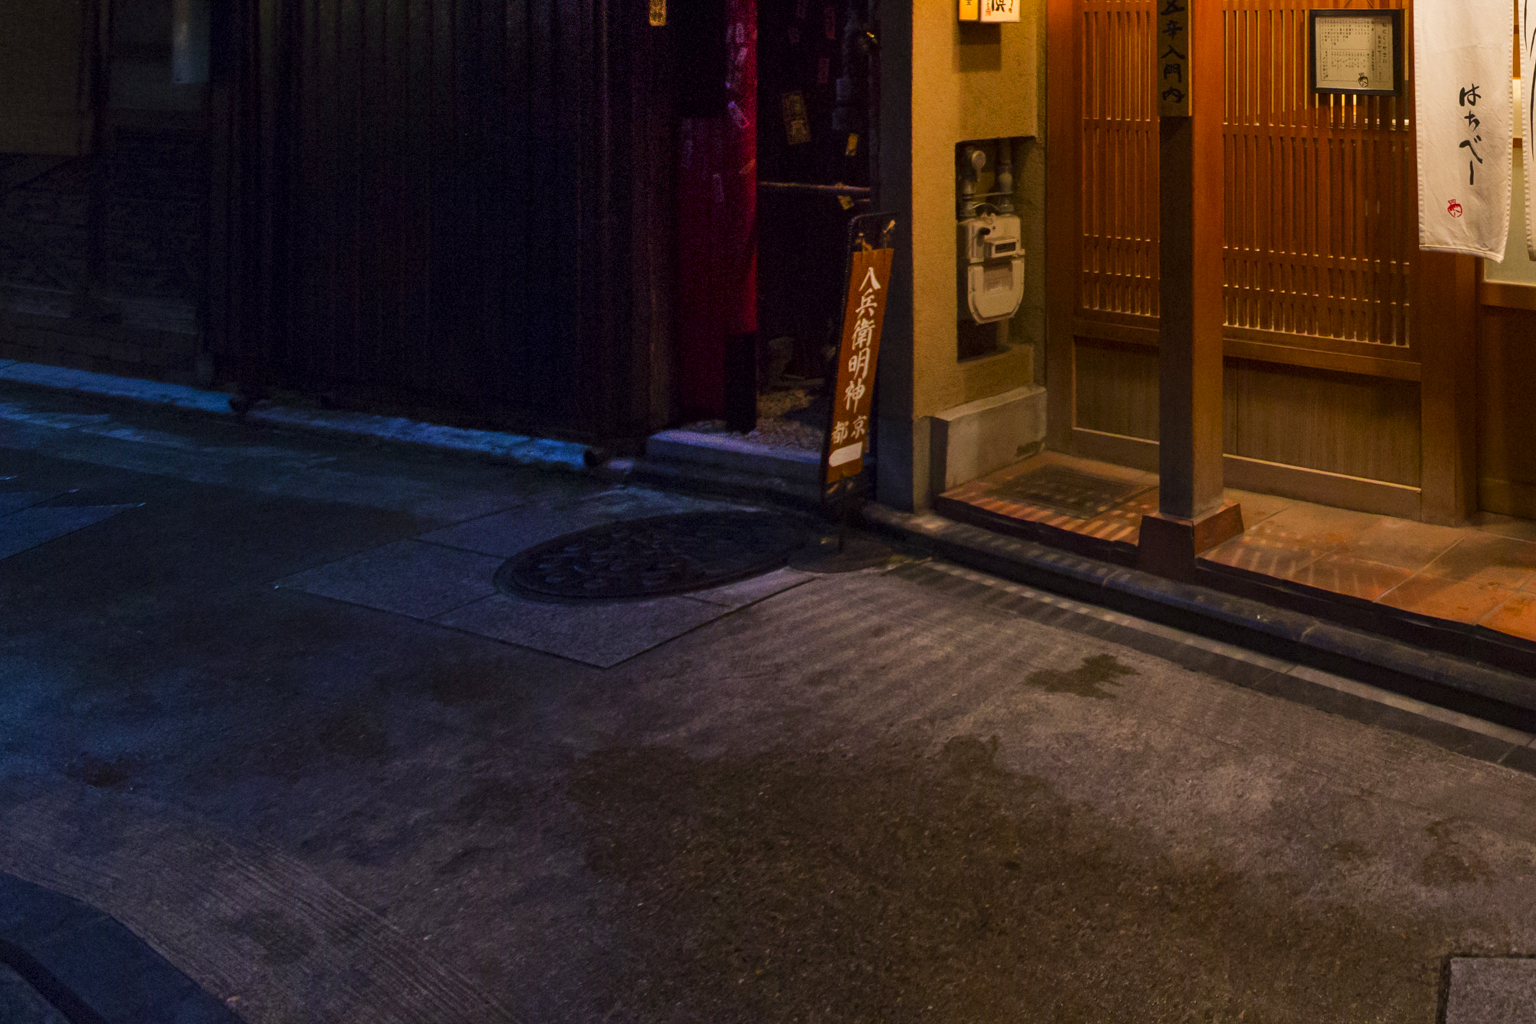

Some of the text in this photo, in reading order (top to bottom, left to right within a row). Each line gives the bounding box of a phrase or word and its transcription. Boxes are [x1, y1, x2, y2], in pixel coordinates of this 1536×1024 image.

[1459, 83, 1483, 185] はちべー
[845, 267, 881, 413] 八兵衛明神
